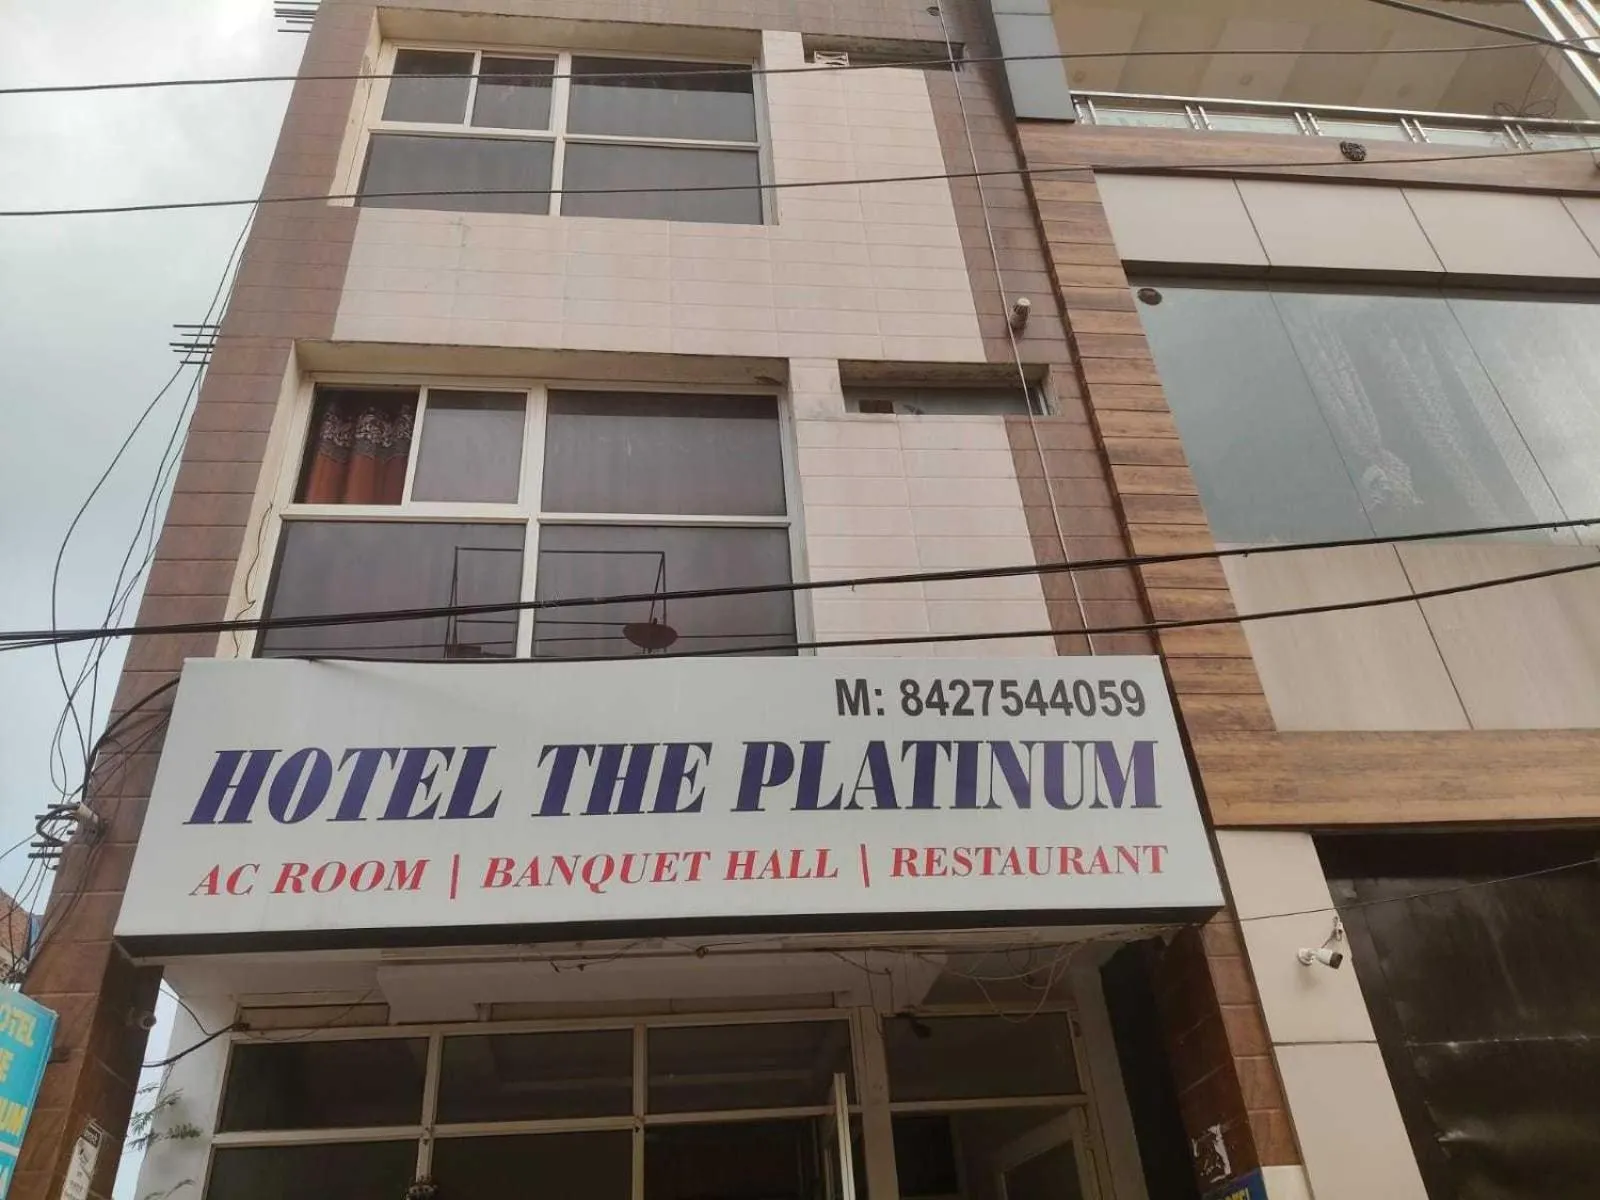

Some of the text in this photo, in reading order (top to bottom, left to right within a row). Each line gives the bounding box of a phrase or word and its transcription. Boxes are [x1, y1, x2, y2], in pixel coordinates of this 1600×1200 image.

[836, 679, 1145, 717] M: 8427544059
[182, 740, 1162, 825] HOTEL THE PLATINUM
[188, 863, 261, 897] AC
[270, 858, 431, 896] ROOM
[480, 850, 711, 893] BANQUET
[724, 847, 839, 882] HALL
[889, 844, 1169, 879] RESTAURANT
